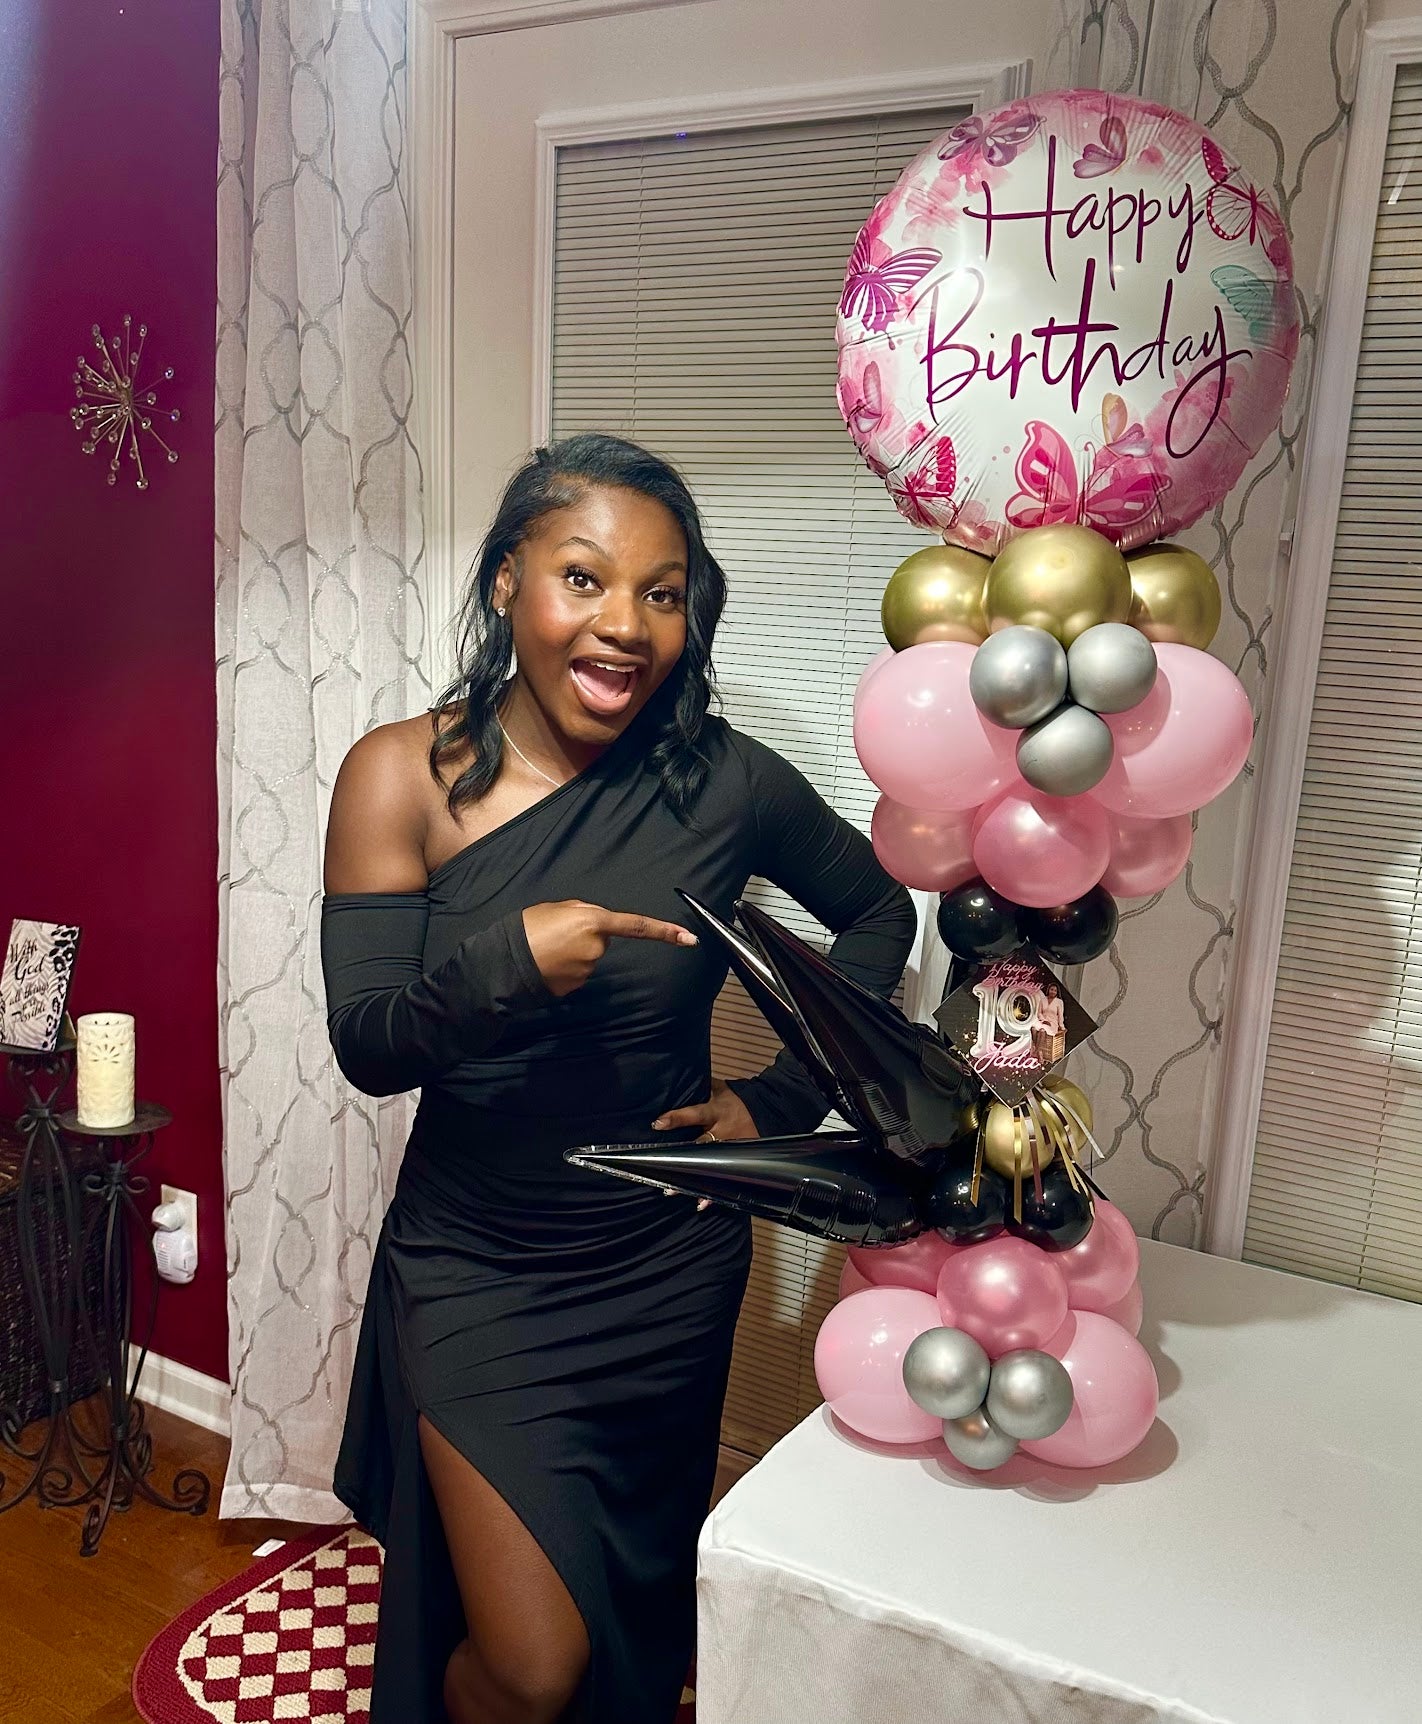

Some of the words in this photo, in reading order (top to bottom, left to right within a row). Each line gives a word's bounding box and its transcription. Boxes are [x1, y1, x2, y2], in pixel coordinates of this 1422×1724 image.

[963, 135, 1205, 291] Happy
[906, 258, 1254, 459] Birthday
[10, 939, 38, 963] With
[15, 953, 48, 985] God
[981, 973, 1045, 994] Birthday
[989, 957, 1038, 979] Happy
[970, 983, 1047, 1058] 19
[973, 1042, 1042, 1074] Jada
